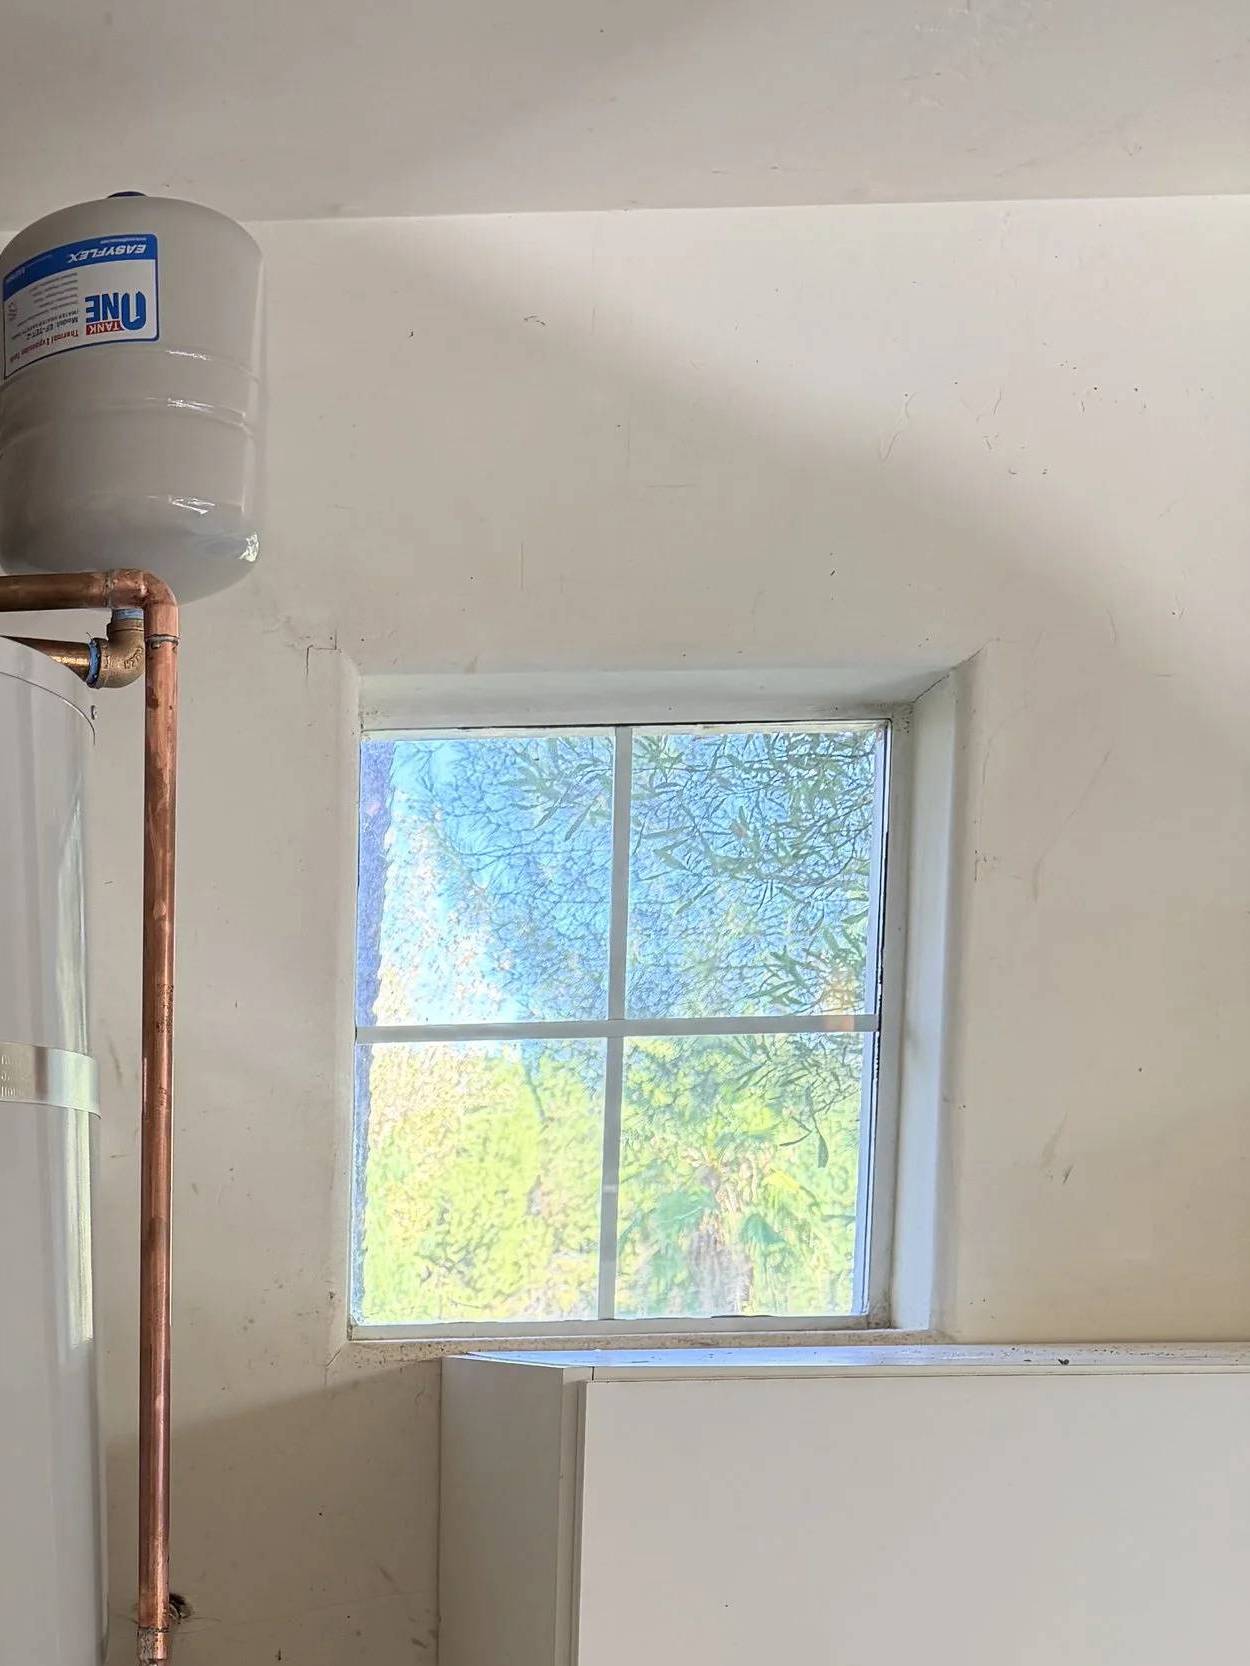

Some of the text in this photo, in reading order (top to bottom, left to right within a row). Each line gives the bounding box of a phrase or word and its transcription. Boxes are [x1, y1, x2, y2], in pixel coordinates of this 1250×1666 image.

[67, 243, 146, 263] EASYFLEX
[57, 316, 78, 328] Model:
[89, 320, 120, 334] TANK
[50, 329, 79, 345] Thermal
[21, 338, 50, 356] Expansion
